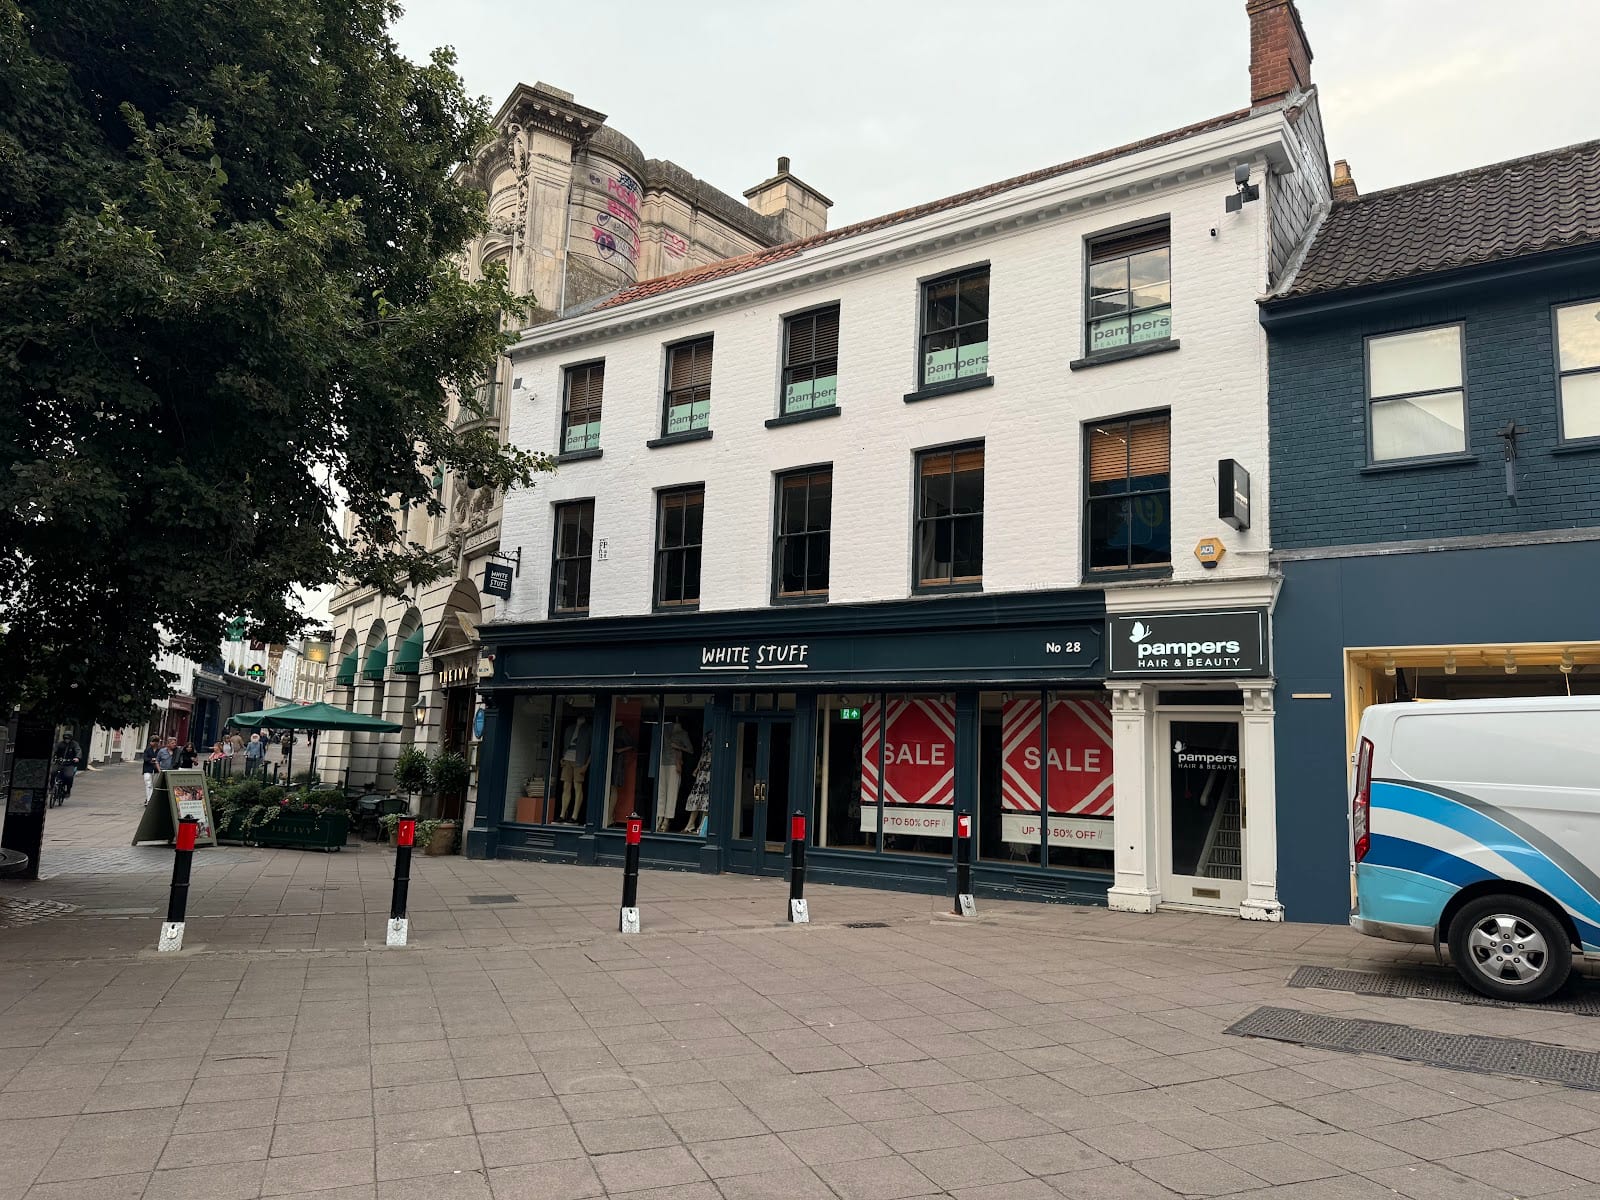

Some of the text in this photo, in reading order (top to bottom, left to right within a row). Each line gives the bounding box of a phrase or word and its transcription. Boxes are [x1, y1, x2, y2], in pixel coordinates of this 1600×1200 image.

[1094, 317, 1170, 342] pampers
[927, 355, 989, 377] pampers
[670, 411, 709, 428] pamper
[568, 432, 600, 445] pamper
[491, 570, 508, 580] WHITE
[490, 579, 507, 588] STUFF
[702, 644, 808, 664] WHITE STUFF
[1046, 641, 1081, 653] No 28
[1138, 641, 1240, 658] pampers
[1138, 658, 1240, 667] HAIR & BEAUTY
[439, 670, 453, 684] THE
[454, 665, 470, 681] IVY
[884, 742, 946, 766] SALE
[1023, 746, 1101, 772] SALE
[1178, 753, 1237, 764] pampers
[883, 817, 889, 825] P
[891, 817, 902, 826] TO
[904, 818, 921, 827] 50%
[923, 819, 941, 827] OFF
[1022, 826, 1035, 835] UP
[1053, 829, 1073, 838] 50%
[1076, 830, 1096, 839] OFF
